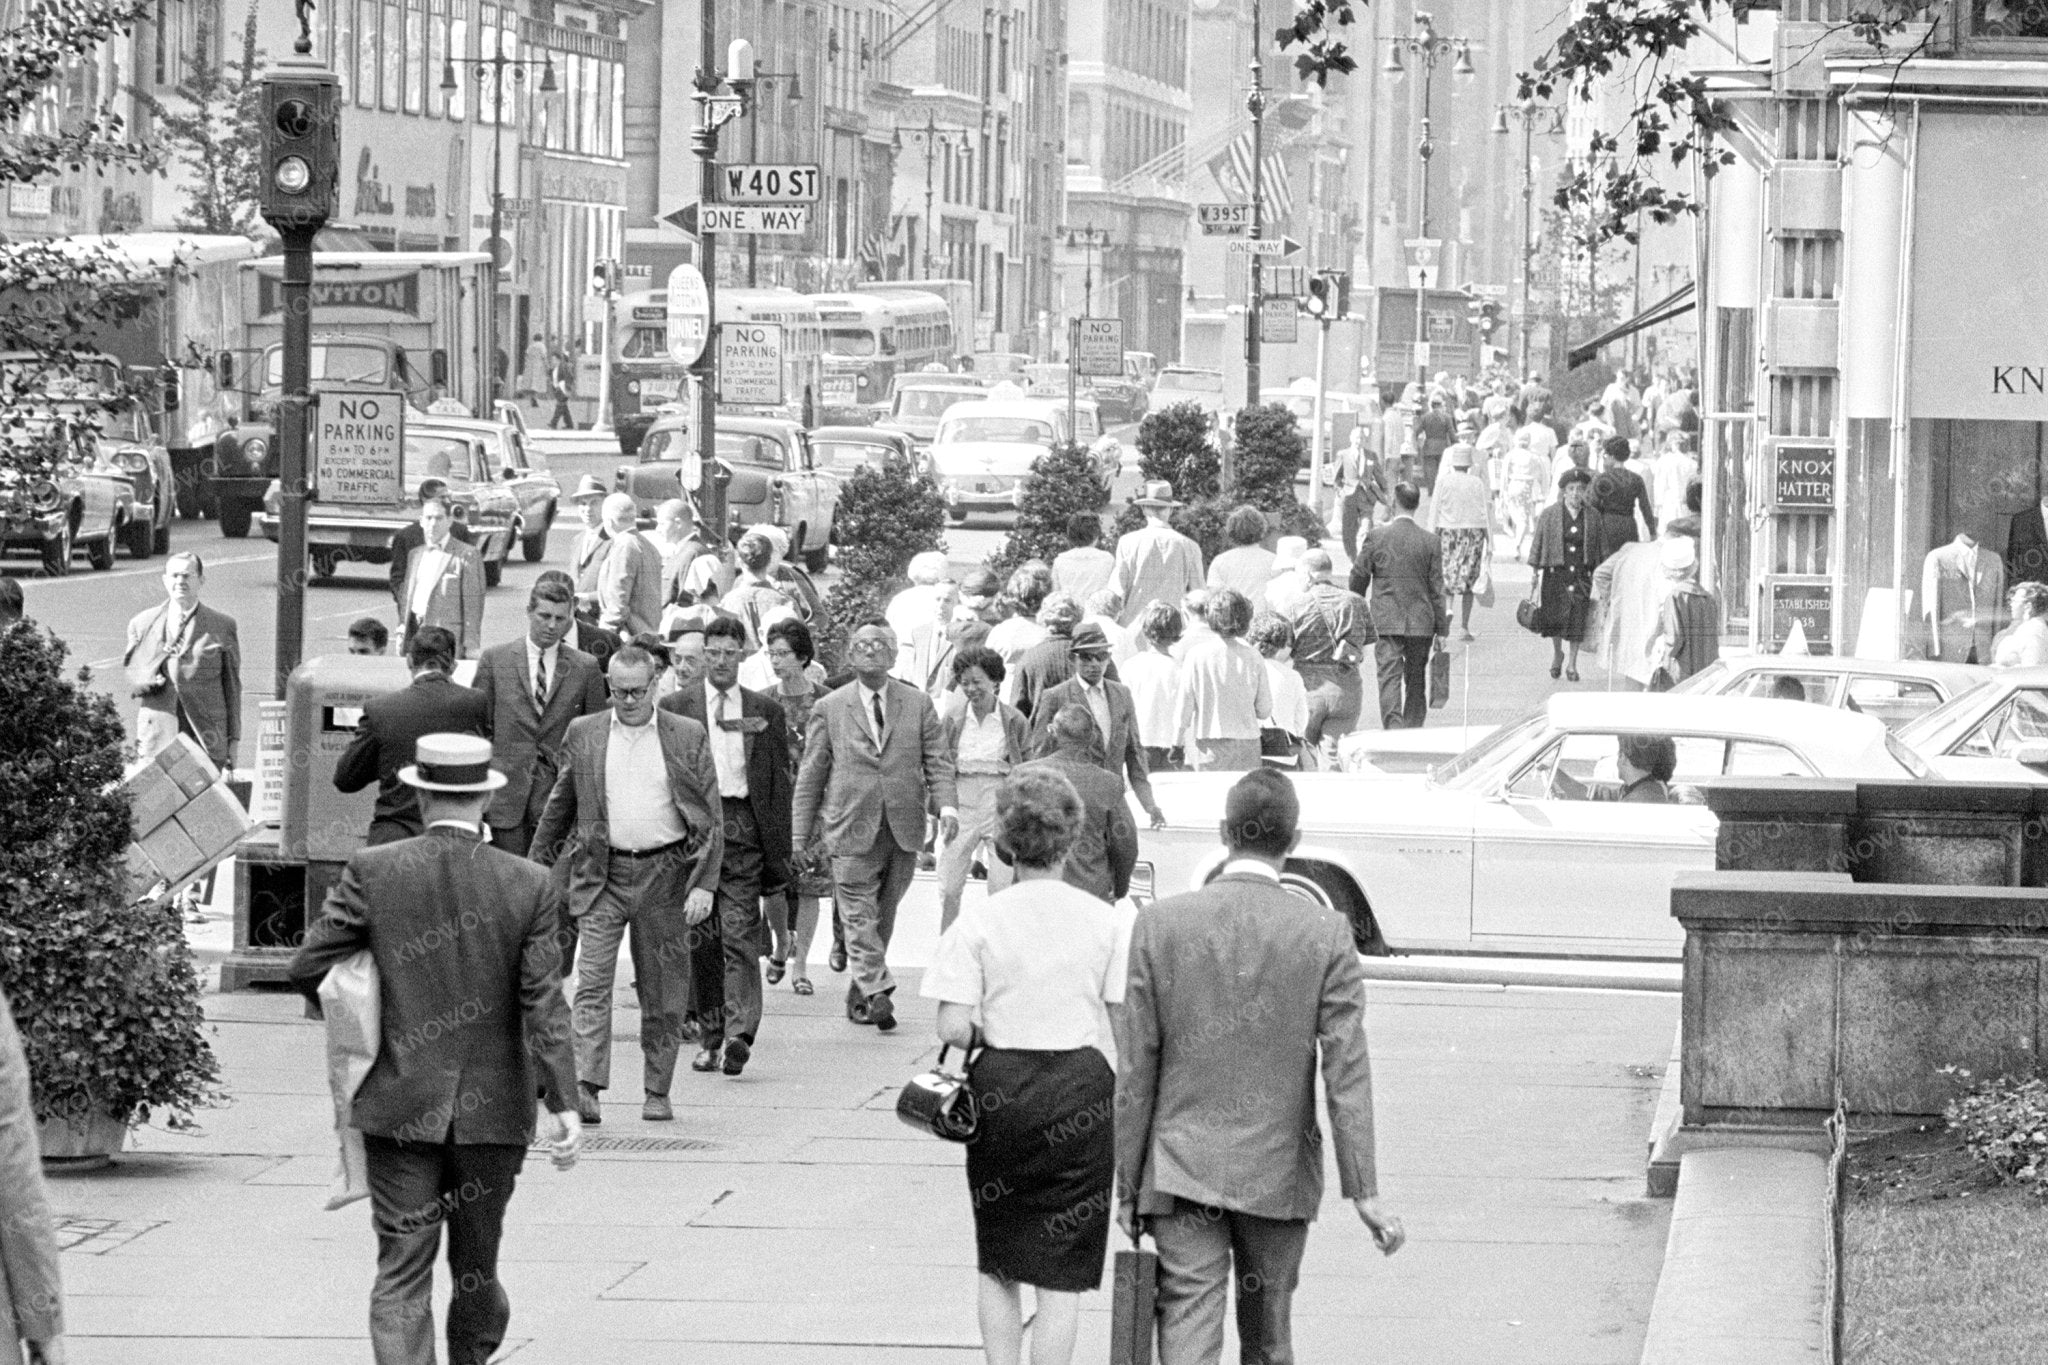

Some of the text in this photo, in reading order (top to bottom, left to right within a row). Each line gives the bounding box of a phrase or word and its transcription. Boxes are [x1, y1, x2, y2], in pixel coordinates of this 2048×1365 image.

[705, 210, 803, 231] ONE WAY
[1232, 206, 1248, 221] ST
[1230, 242, 1280, 253] ONE WAY
[273, 281, 405, 308] LVITON
[1091, 323, 1112, 334] NO
[736, 329, 766, 343] NO
[725, 346, 778, 359] PARKING
[340, 400, 380, 420] NO
[324, 424, 395, 441] PARKING
[354, 445, 366, 455] TO
[321, 467, 397, 480] NO COMMERCIAL
[1778, 460, 1834, 476] KNOX
[337, 481, 380, 493] TRAFFIC
[1778, 481, 1832, 497] HATTER
